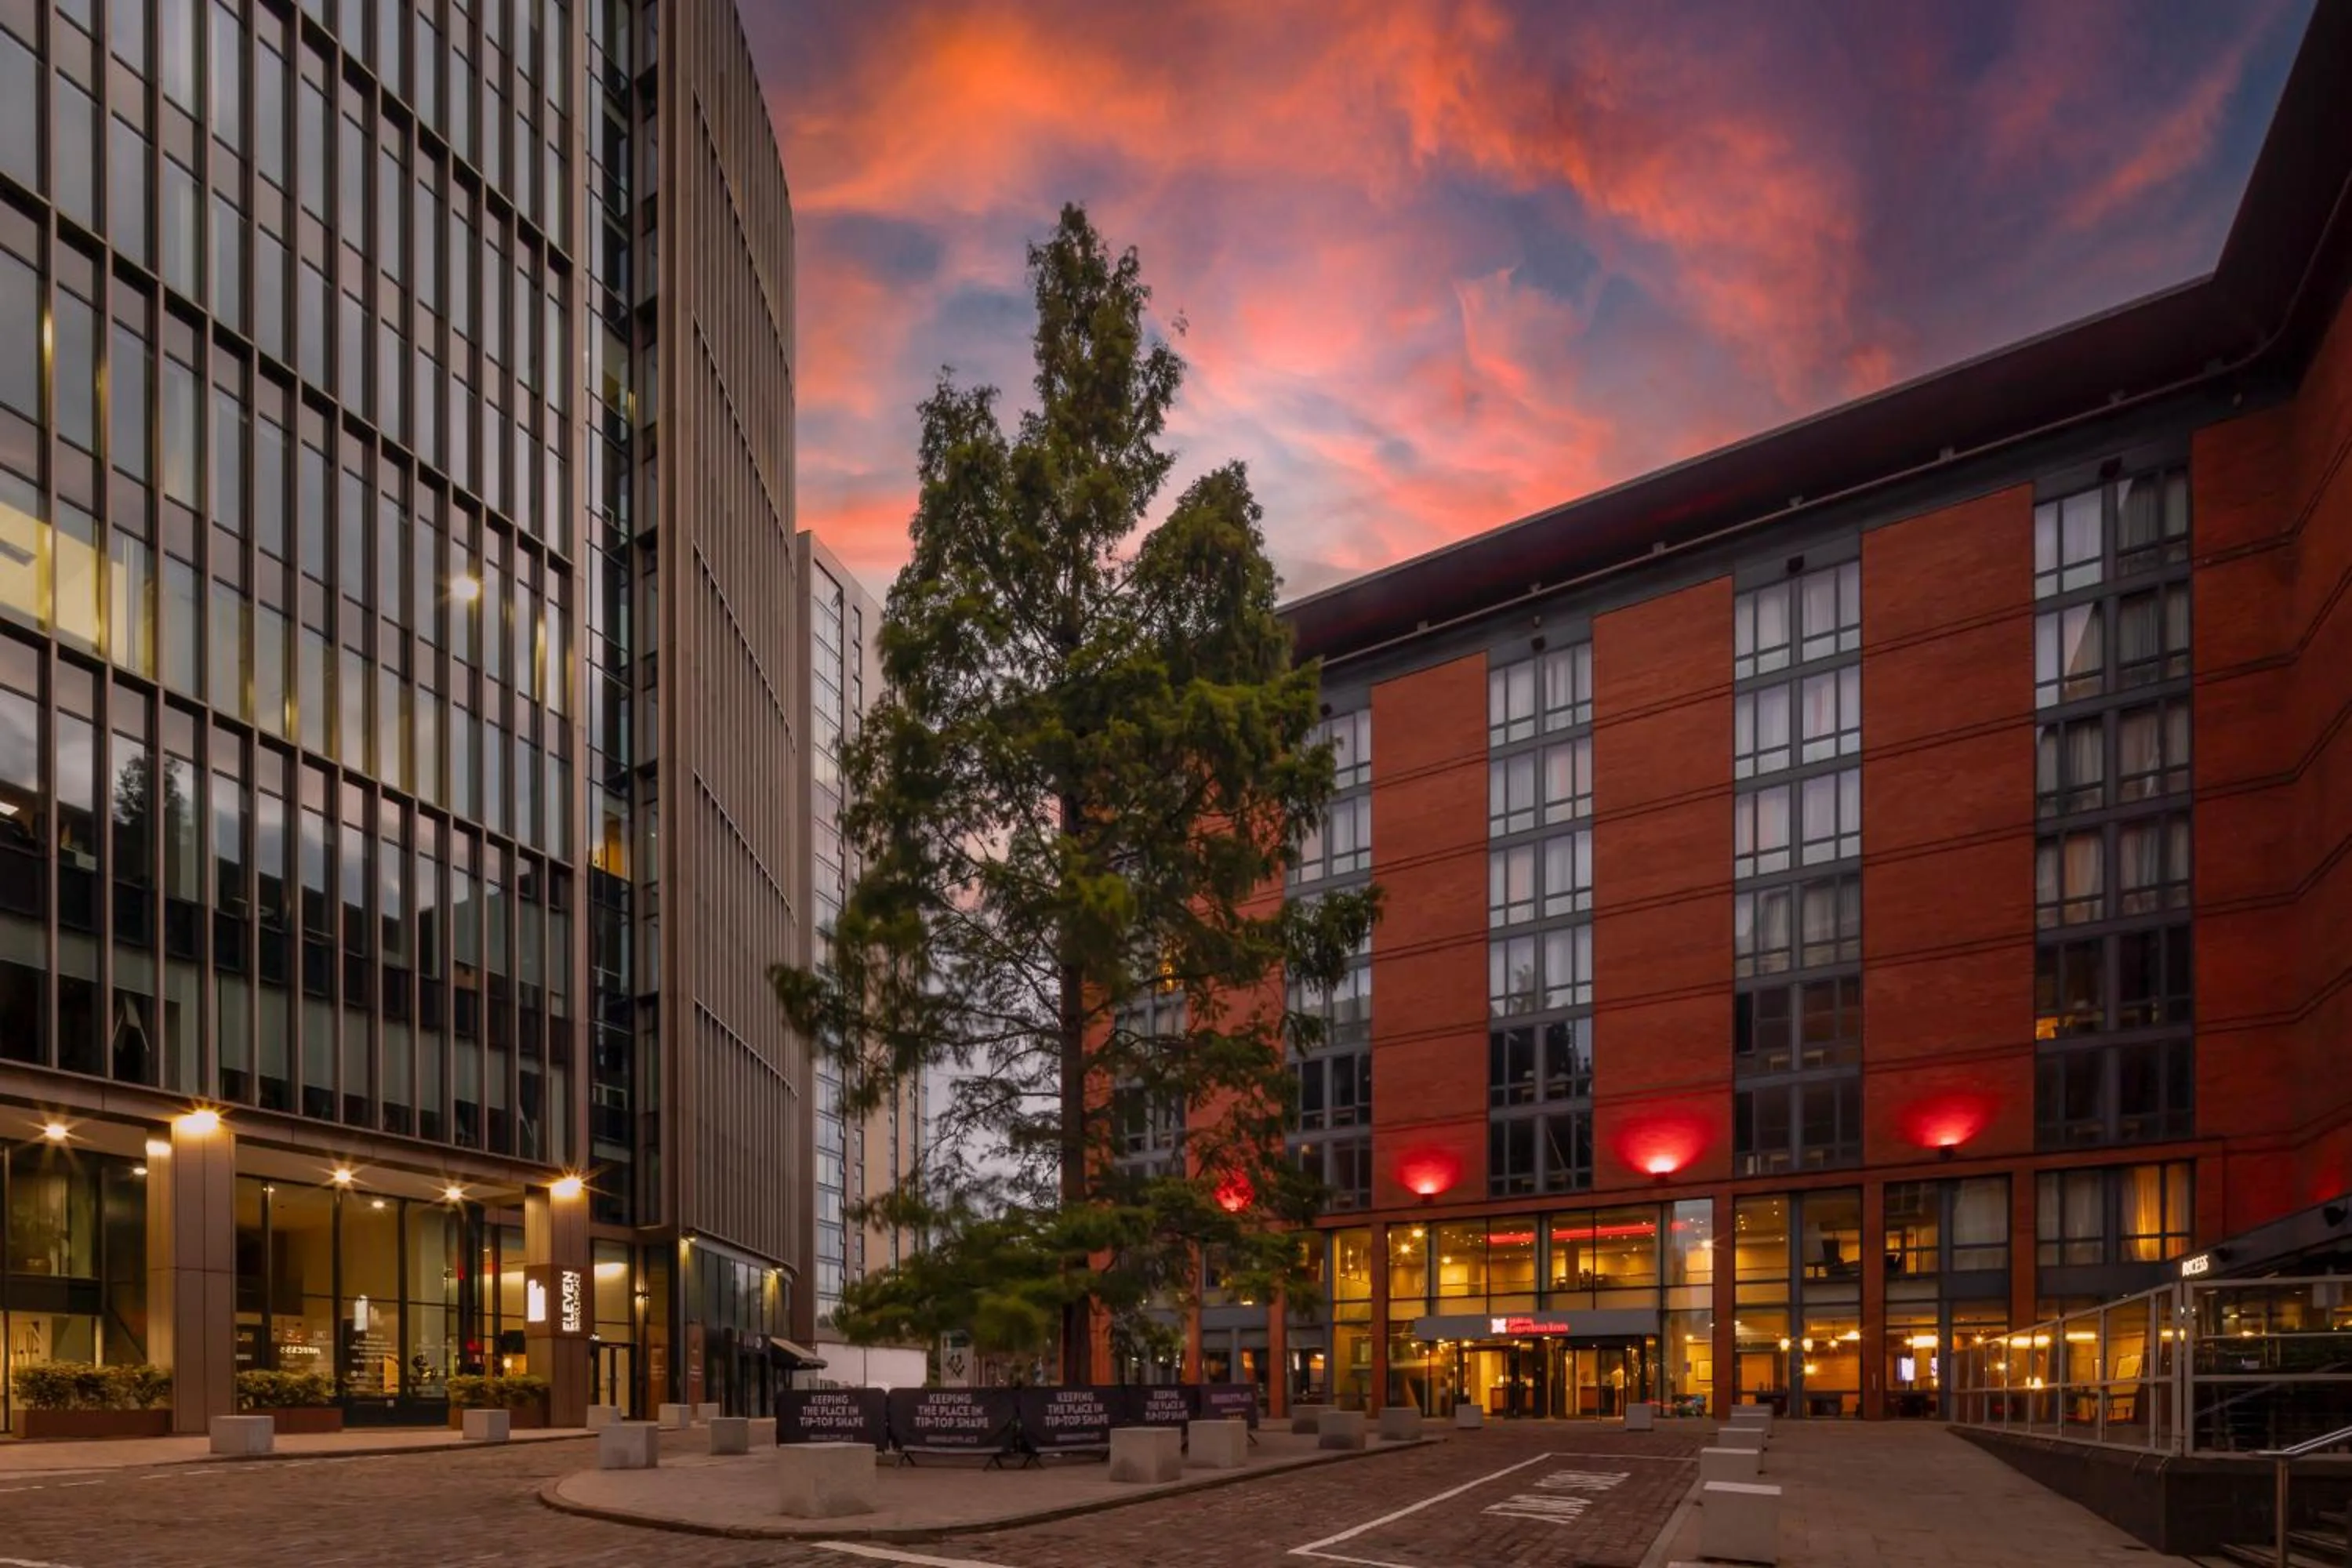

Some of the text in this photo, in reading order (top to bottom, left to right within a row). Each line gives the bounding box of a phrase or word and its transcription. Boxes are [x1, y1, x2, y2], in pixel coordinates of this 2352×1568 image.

[562, 1271, 574, 1331] ELEVEN
[811, 1395, 849, 1405] KEEPING
[928, 1393, 972, 1404] KEEPING
[1056, 1392, 1094, 1403] KEEPING
[803, 1406, 858, 1416] THE PLACE IN
[917, 1405, 984, 1416] THE PLACE IN
[1047, 1403, 1104, 1414] THE PLACE IN
[800, 1417, 864, 1427] TIP-TOP SHAPE
[915, 1417, 989, 1428] TIP-TOP SHAPE
[1044, 1414, 1109, 1426] TIP-TOP SHAPE
